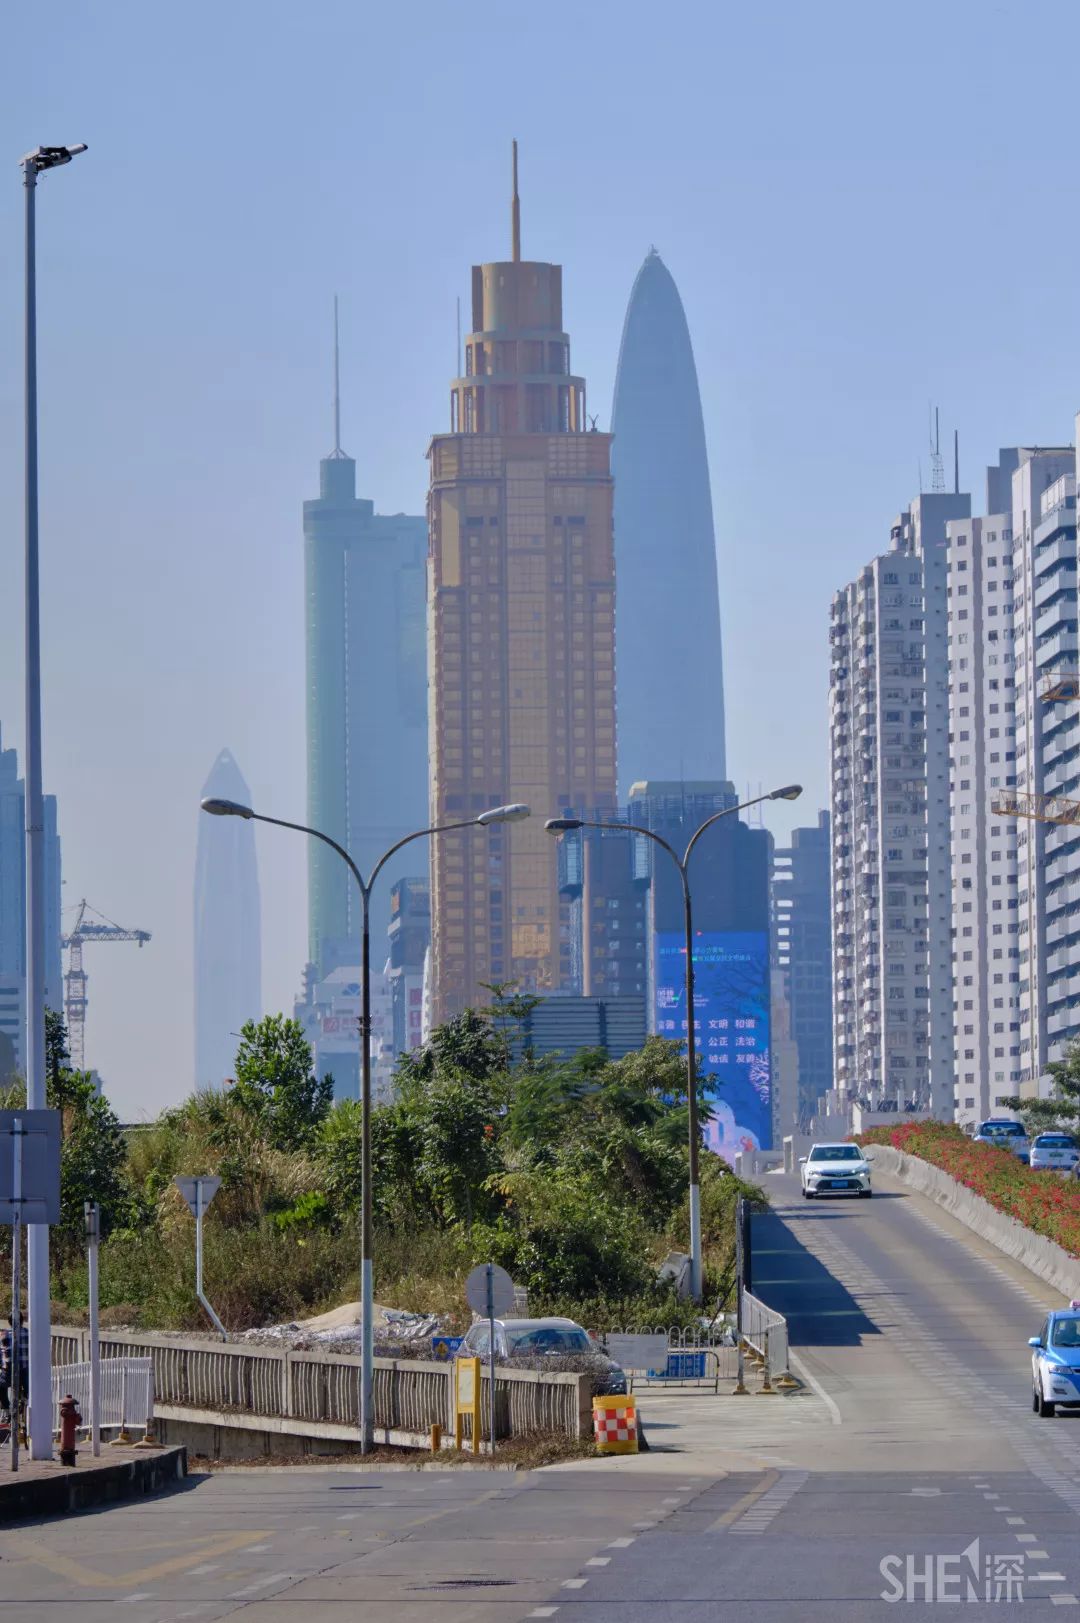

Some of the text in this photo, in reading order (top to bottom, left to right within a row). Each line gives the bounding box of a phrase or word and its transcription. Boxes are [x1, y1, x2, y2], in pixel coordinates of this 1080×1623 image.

[708, 1019, 728, 1029] 文明
[735, 1019, 755, 1029] 和谐
[708, 1036, 728, 1046] 公正
[735, 1036, 755, 1046] 法治
